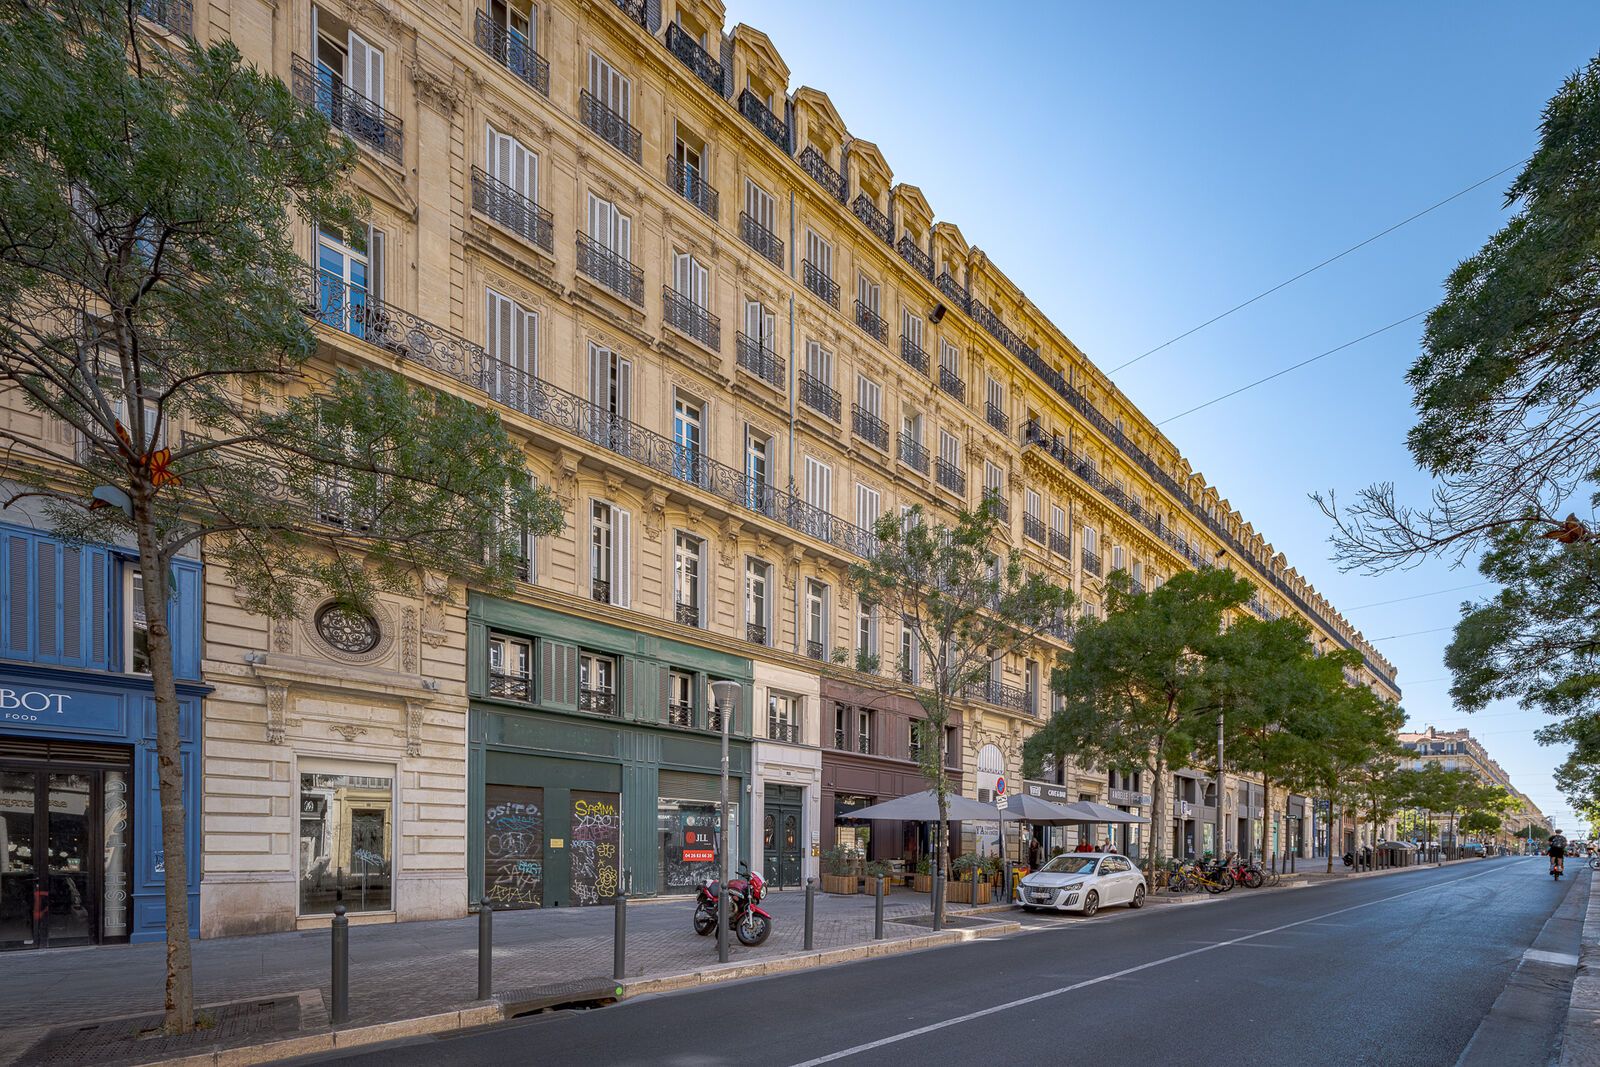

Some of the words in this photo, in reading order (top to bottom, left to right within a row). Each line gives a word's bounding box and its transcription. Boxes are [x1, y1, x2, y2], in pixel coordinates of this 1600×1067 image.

[5, 713, 38, 721] FOOD
[696, 834, 708, 842] JLL
[104, 871, 127, 928] FISH
